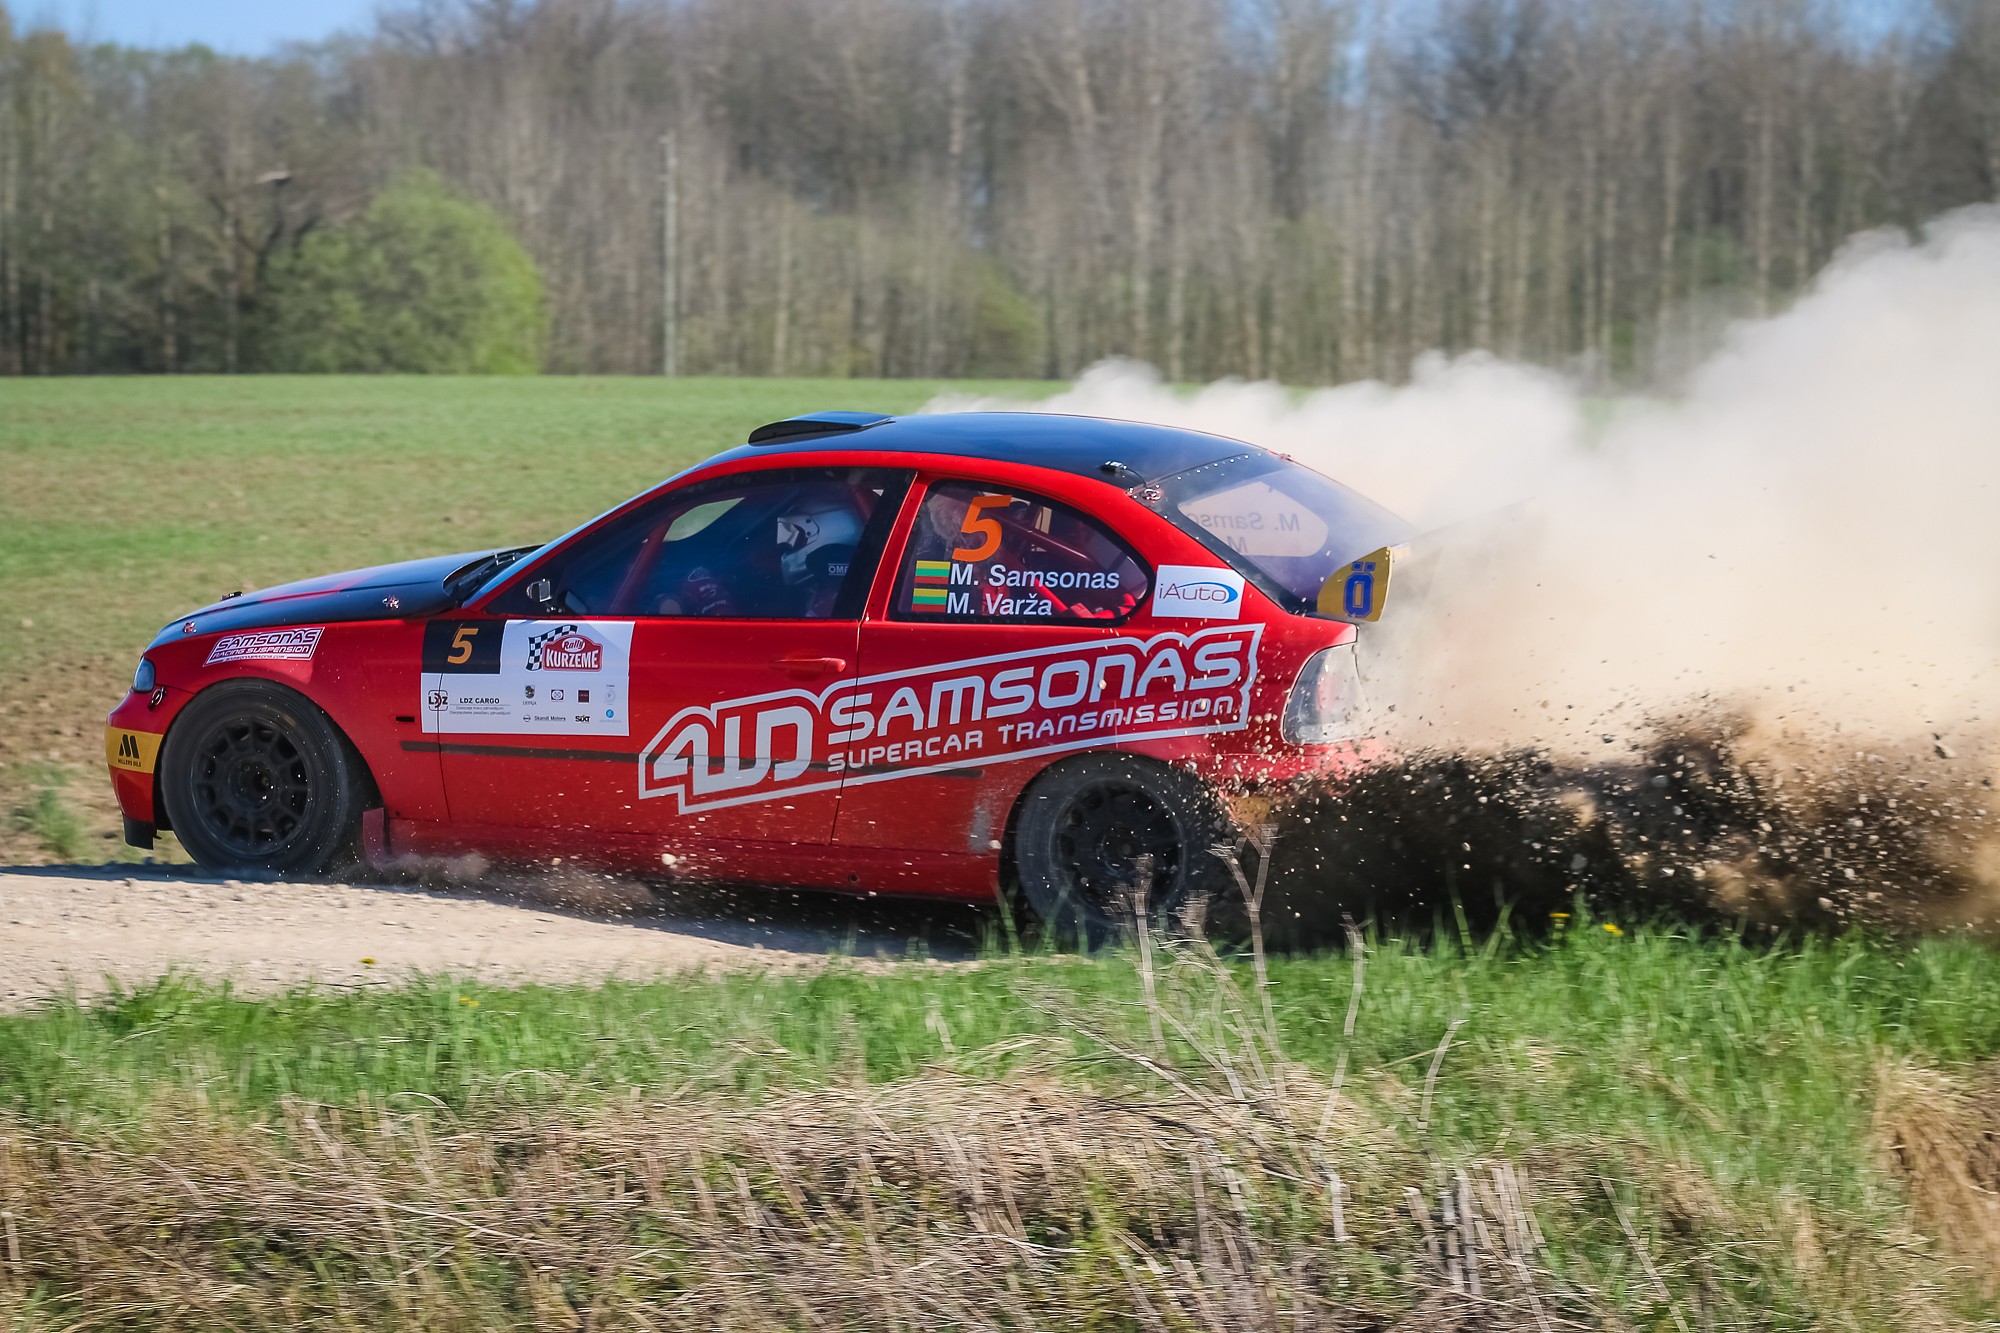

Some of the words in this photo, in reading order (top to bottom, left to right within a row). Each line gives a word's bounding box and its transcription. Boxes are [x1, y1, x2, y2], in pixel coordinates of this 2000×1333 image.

[952, 495, 1012, 562] 5
[950, 564, 979, 586] M.
[988, 564, 1120, 590] Samsonas
[1158, 582, 1228, 602] iAuto
[1343, 562, 1376, 618] Ö
[947, 593, 975, 615] M.
[986, 594, 1052, 616] Varža
[212, 648, 245, 658] RACING
[246, 645, 310, 654] SUSPENSION
[216, 630, 318, 652] SAMSONAS
[447, 628, 479, 664] 5
[563, 639, 584, 650] Rally
[546, 648, 599, 668] KURZEME
[828, 640, 1243, 745] SAMSONAS
[828, 730, 983, 773] SUPERCAR
[998, 696, 1235, 745] TRANSMISSION
